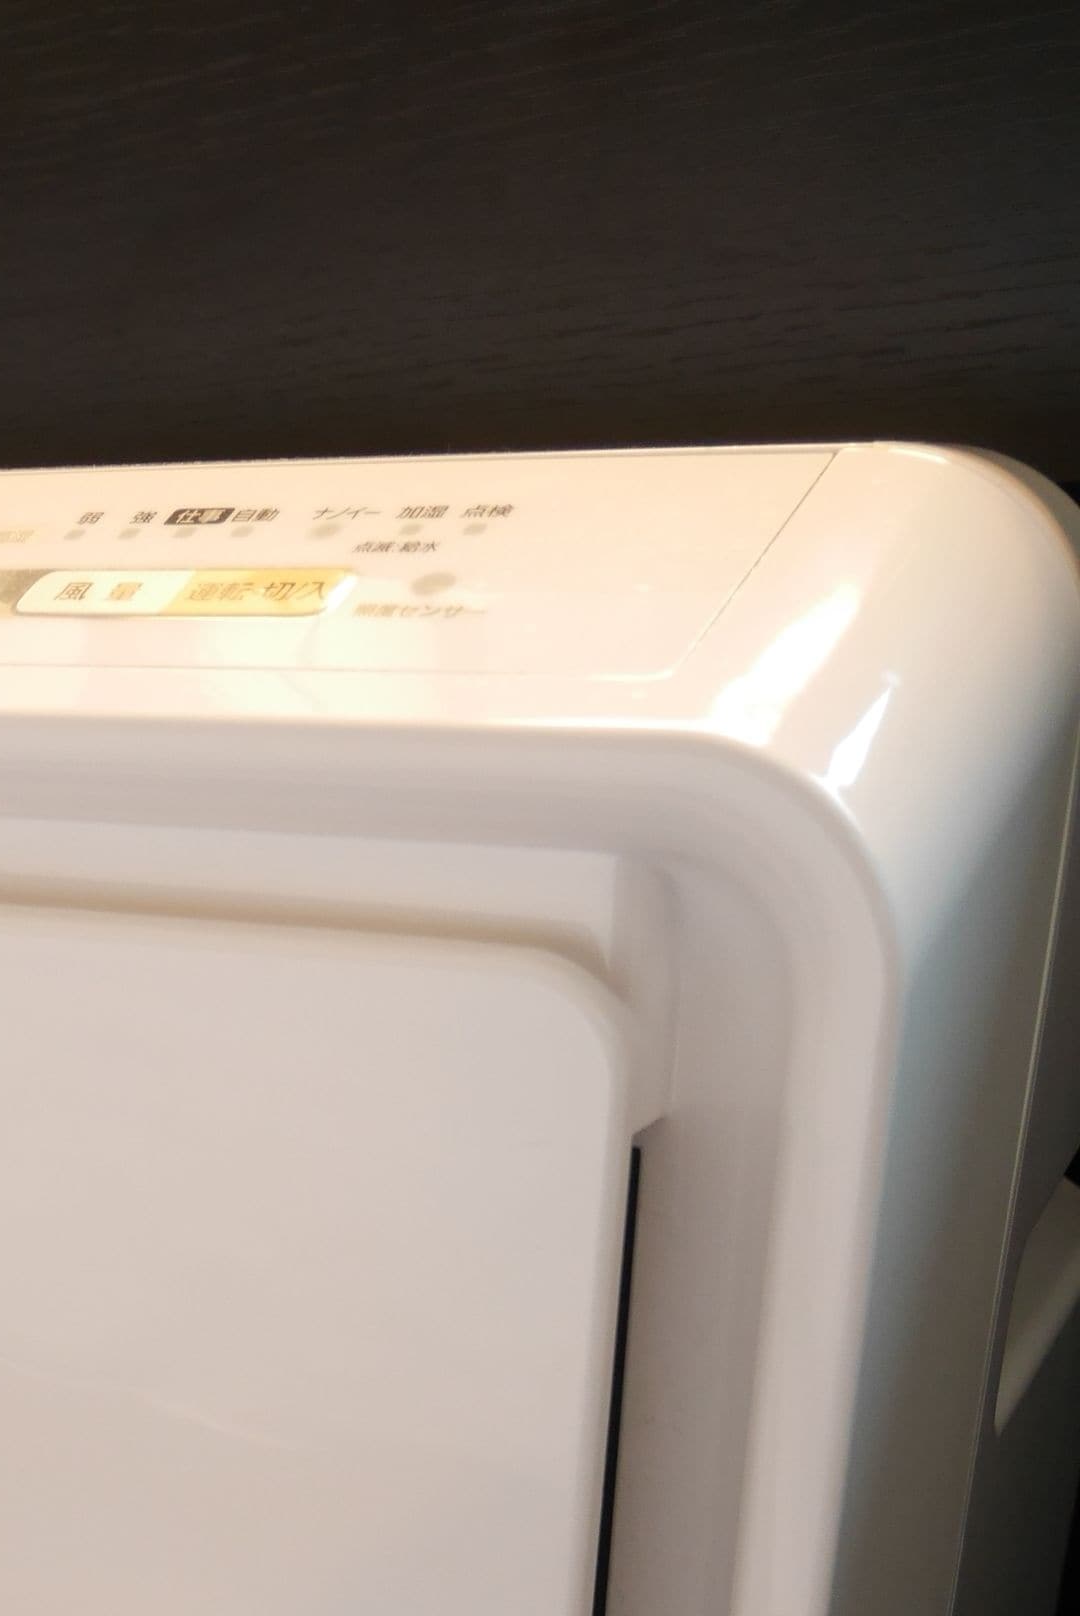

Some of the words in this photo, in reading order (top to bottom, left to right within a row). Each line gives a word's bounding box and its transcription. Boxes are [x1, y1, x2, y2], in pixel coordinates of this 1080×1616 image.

[128, 510, 157, 524] 強
[231, 508, 280, 523] 自動
[312, 508, 382, 520] ナノイー
